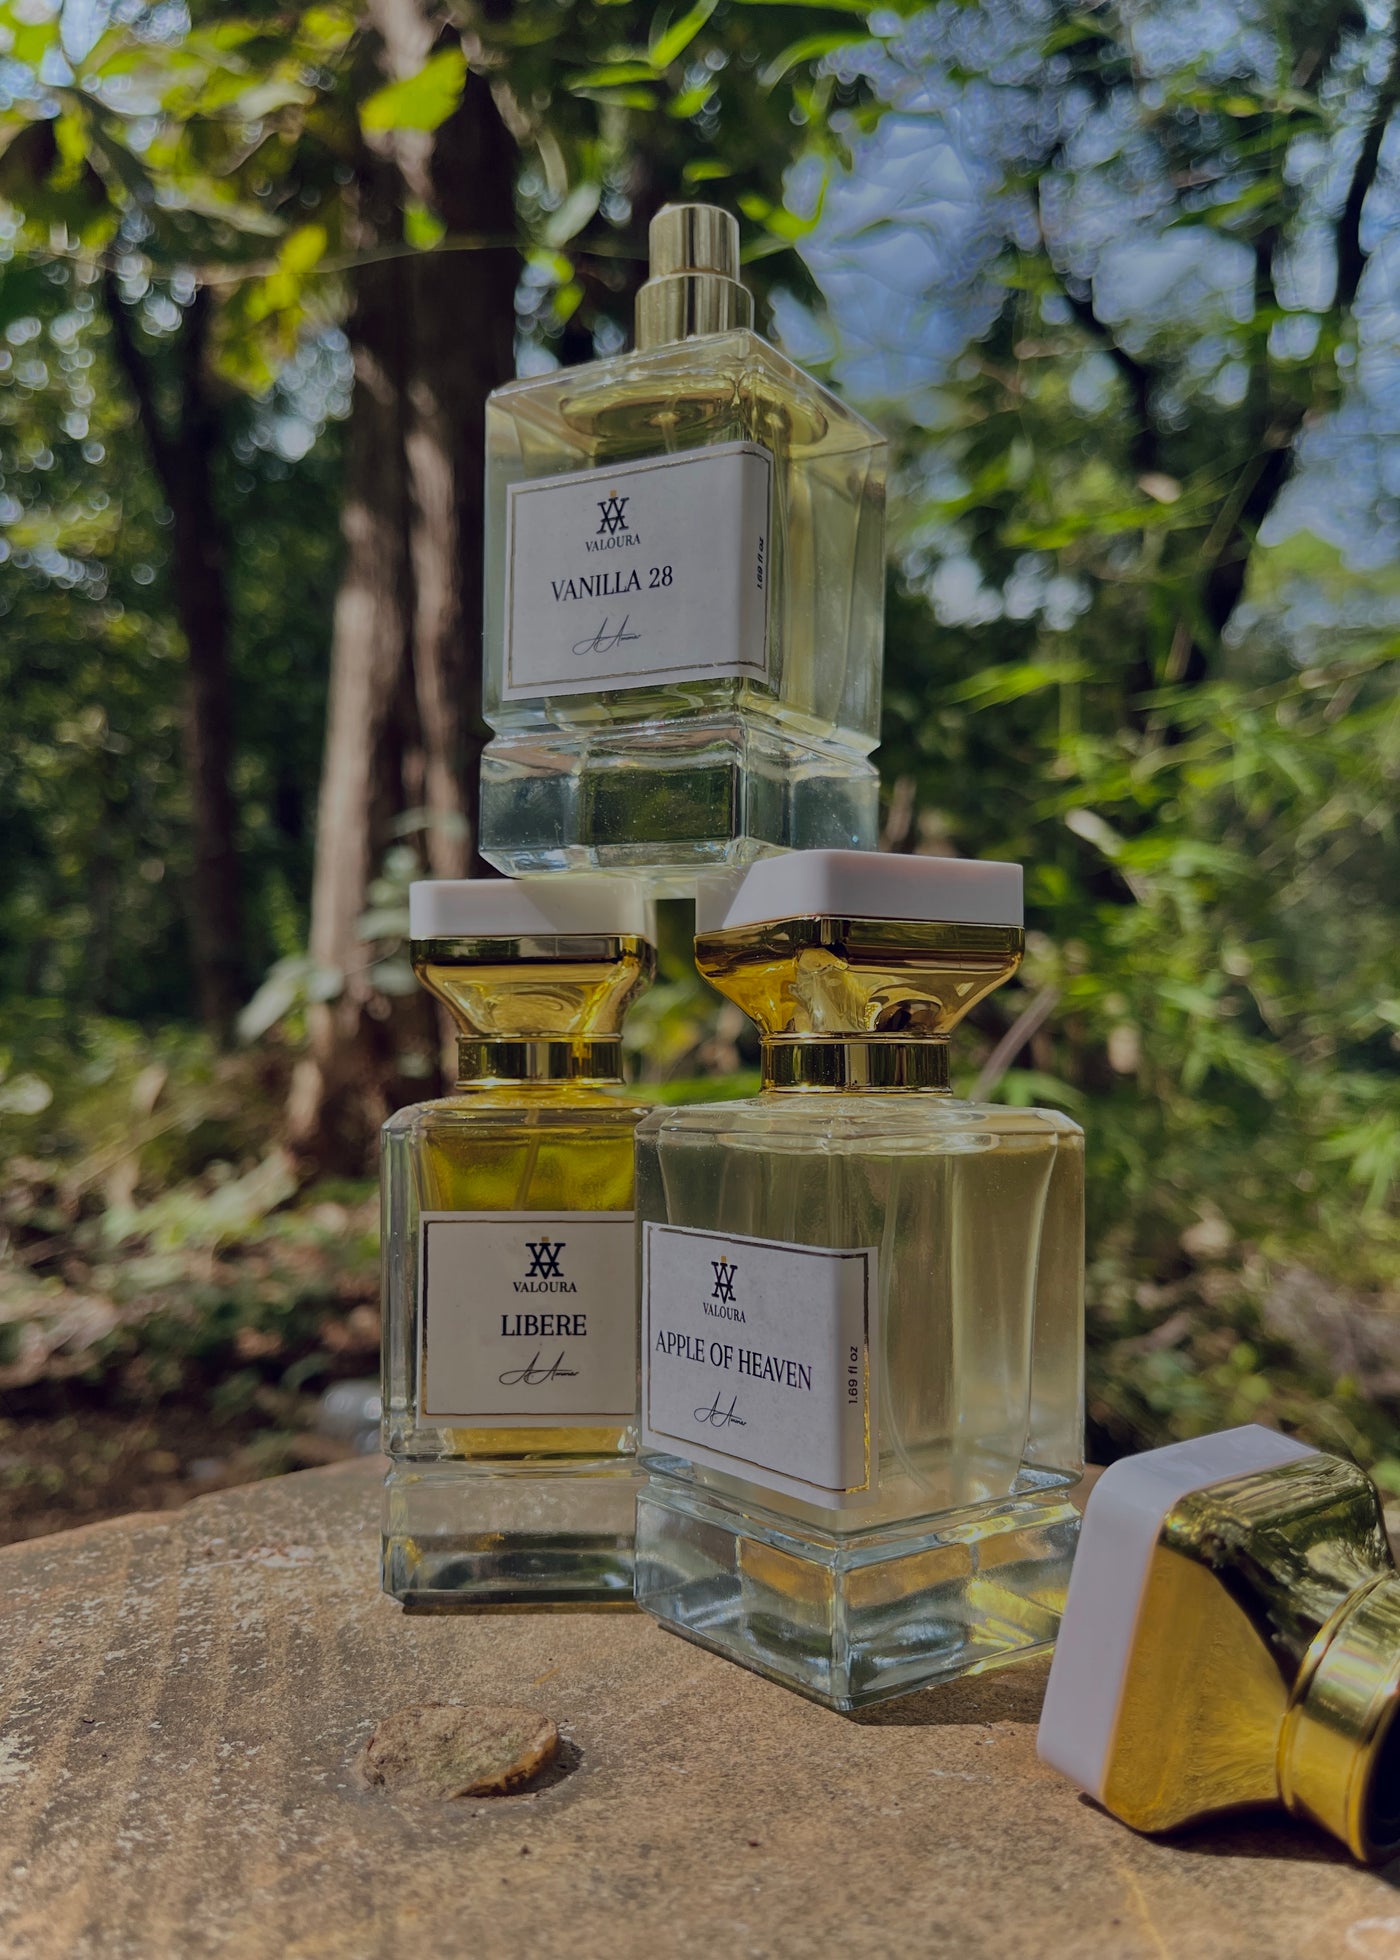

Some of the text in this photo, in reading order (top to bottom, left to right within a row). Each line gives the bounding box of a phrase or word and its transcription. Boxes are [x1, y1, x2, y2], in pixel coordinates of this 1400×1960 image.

[585, 533, 641, 552] VALOURA
[551, 565, 673, 602] VANILLA 28
[513, 1281, 577, 1293] VALOURA
[703, 1302, 746, 1324] VALOURA
[501, 1314, 587, 1336] LIBERE
[655, 1330, 812, 1392] APPLE OF HEAVEN
[848, 1346, 858, 1404] 1.69 fl oz
